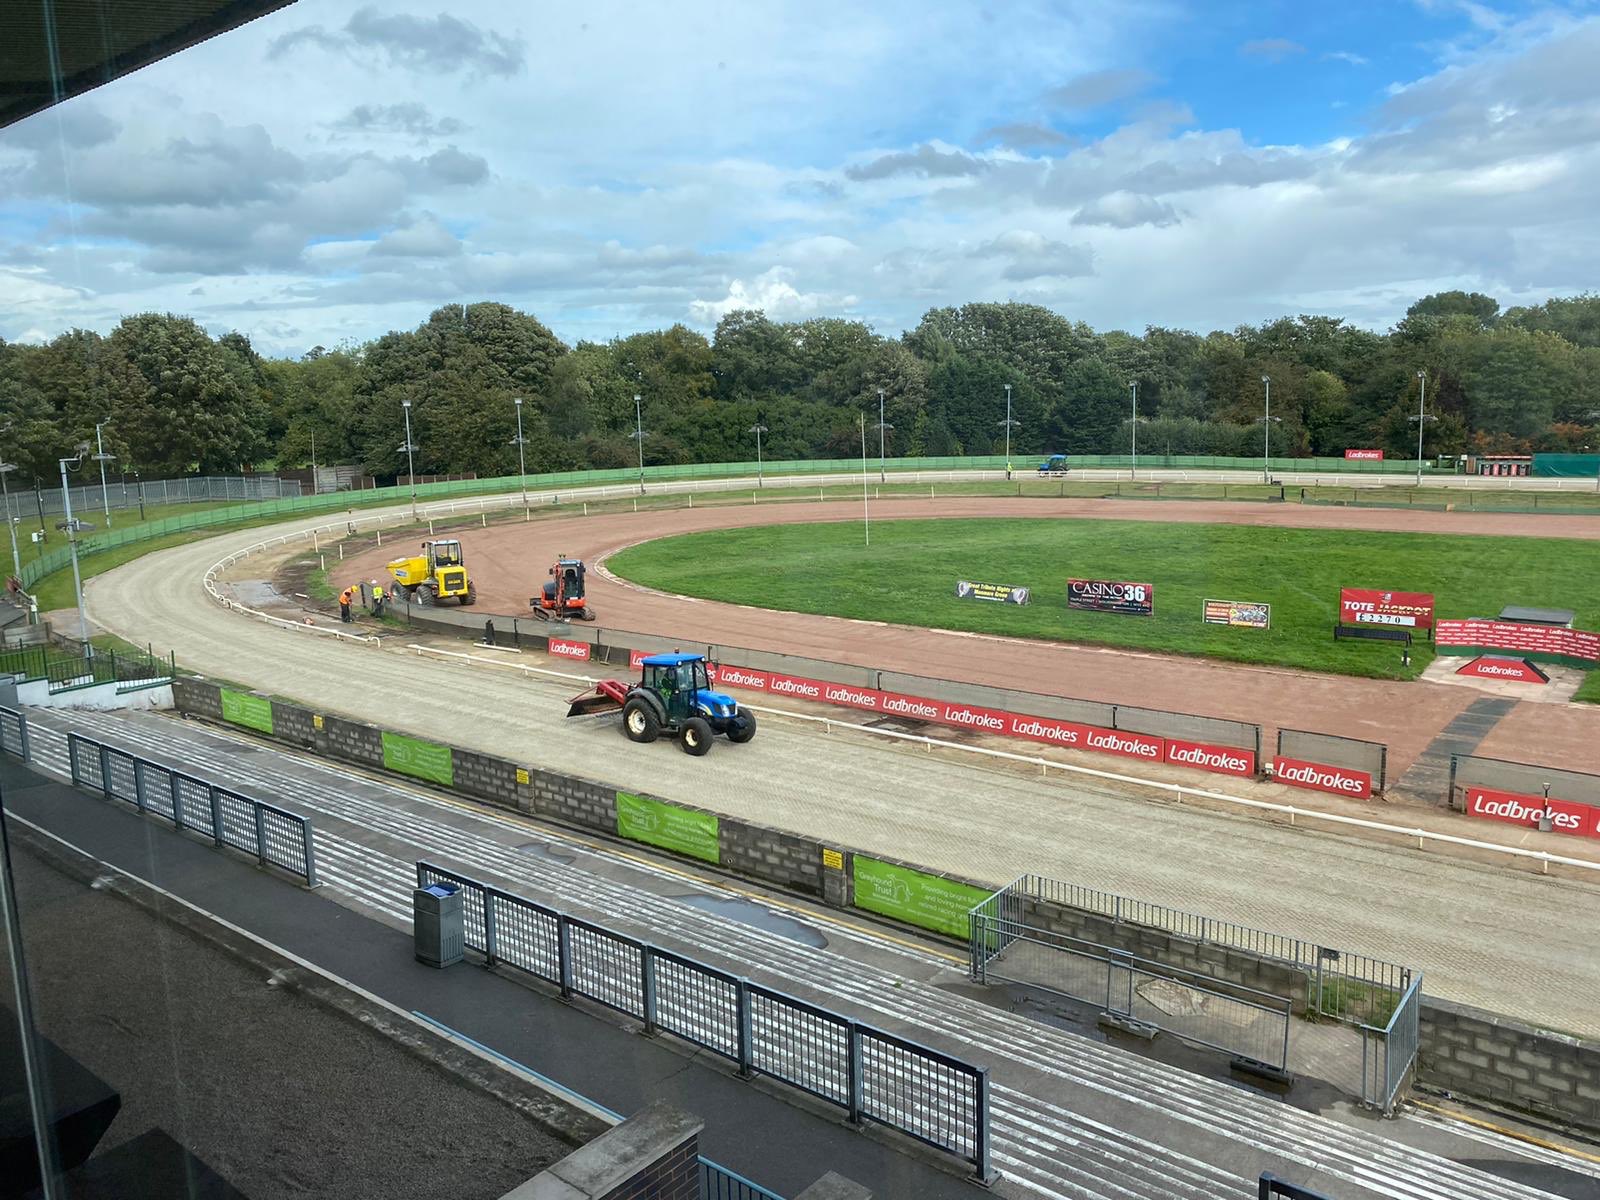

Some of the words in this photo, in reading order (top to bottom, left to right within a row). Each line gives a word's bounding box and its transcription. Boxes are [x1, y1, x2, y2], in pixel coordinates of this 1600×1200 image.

[1349, 451, 1379, 459] Ladbrokes
[1344, 601, 1375, 612] TOTE
[1377, 604, 1431, 616] JACKPOT
[551, 641, 586, 657] Ladbrokes
[721, 670, 765, 688] Ladbrokes
[1478, 664, 1523, 677] Ladbrokes
[771, 678, 819, 697] Ladbrokes
[825, 687, 876, 706] Ladbrokes
[883, 696, 938, 718] Ladbrokes
[945, 706, 1004, 729] Ladbrokes
[1012, 719, 1078, 742] Ladbrokes
[1087, 731, 1158, 757] Ladbrokes
[1169, 745, 1248, 771] Ladbrokes
[1277, 762, 1364, 793] Ladbrokes
[1474, 795, 1581, 829] Ladbrokes
[873, 883, 892, 896] Trust
